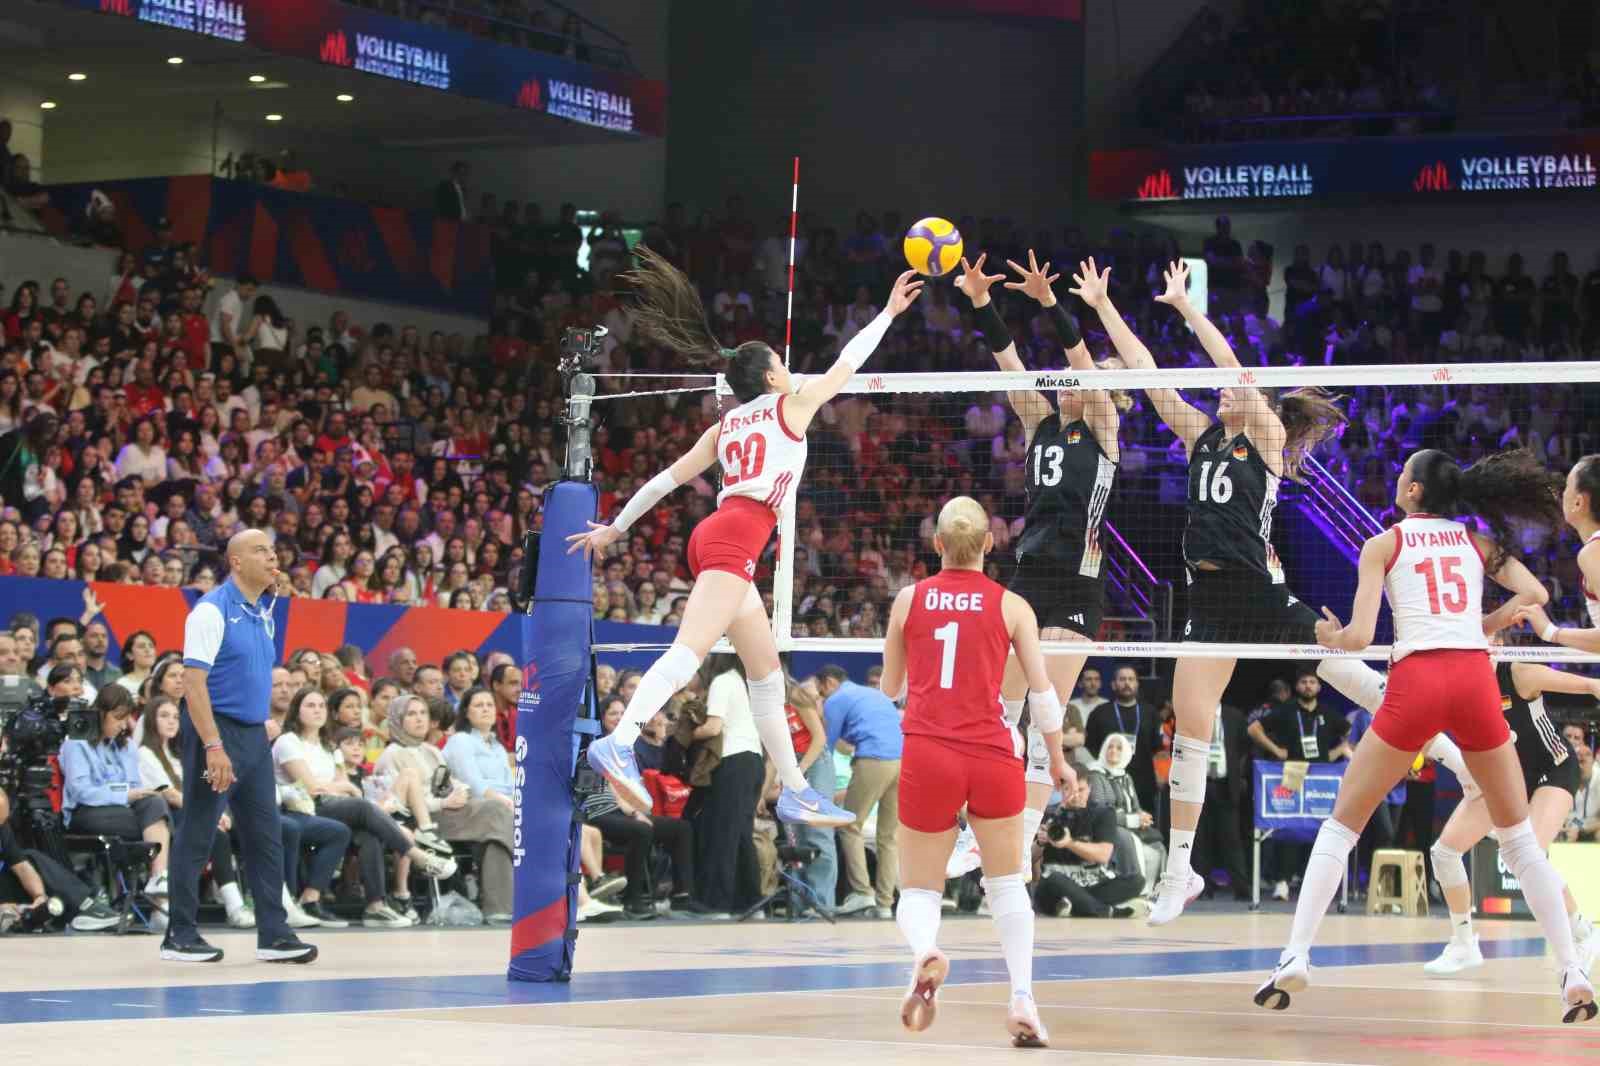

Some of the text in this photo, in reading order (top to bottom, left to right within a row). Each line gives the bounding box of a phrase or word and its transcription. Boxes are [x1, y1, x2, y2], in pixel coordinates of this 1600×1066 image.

[142, 0, 246, 26] LLEYBALL
[355, 32, 450, 74] VOLLEYBALL
[548, 79, 632, 116] VOLLEYBALL
[1183, 161, 1312, 185] VOLLEYBALL
[1461, 154, 1596, 176] VOLLEYBALL
[1184, 185, 1249, 199] NATIONS
[1461, 176, 1530, 191] NATIONS
[723, 432, 767, 487] 20
[1034, 444, 1064, 487] 13
[1198, 460, 1233, 504] 16
[1405, 530, 1469, 548] UYANIK
[925, 587, 984, 612] ÖRGE
[1414, 556, 1468, 614] 15
[934, 620, 959, 689] 1
